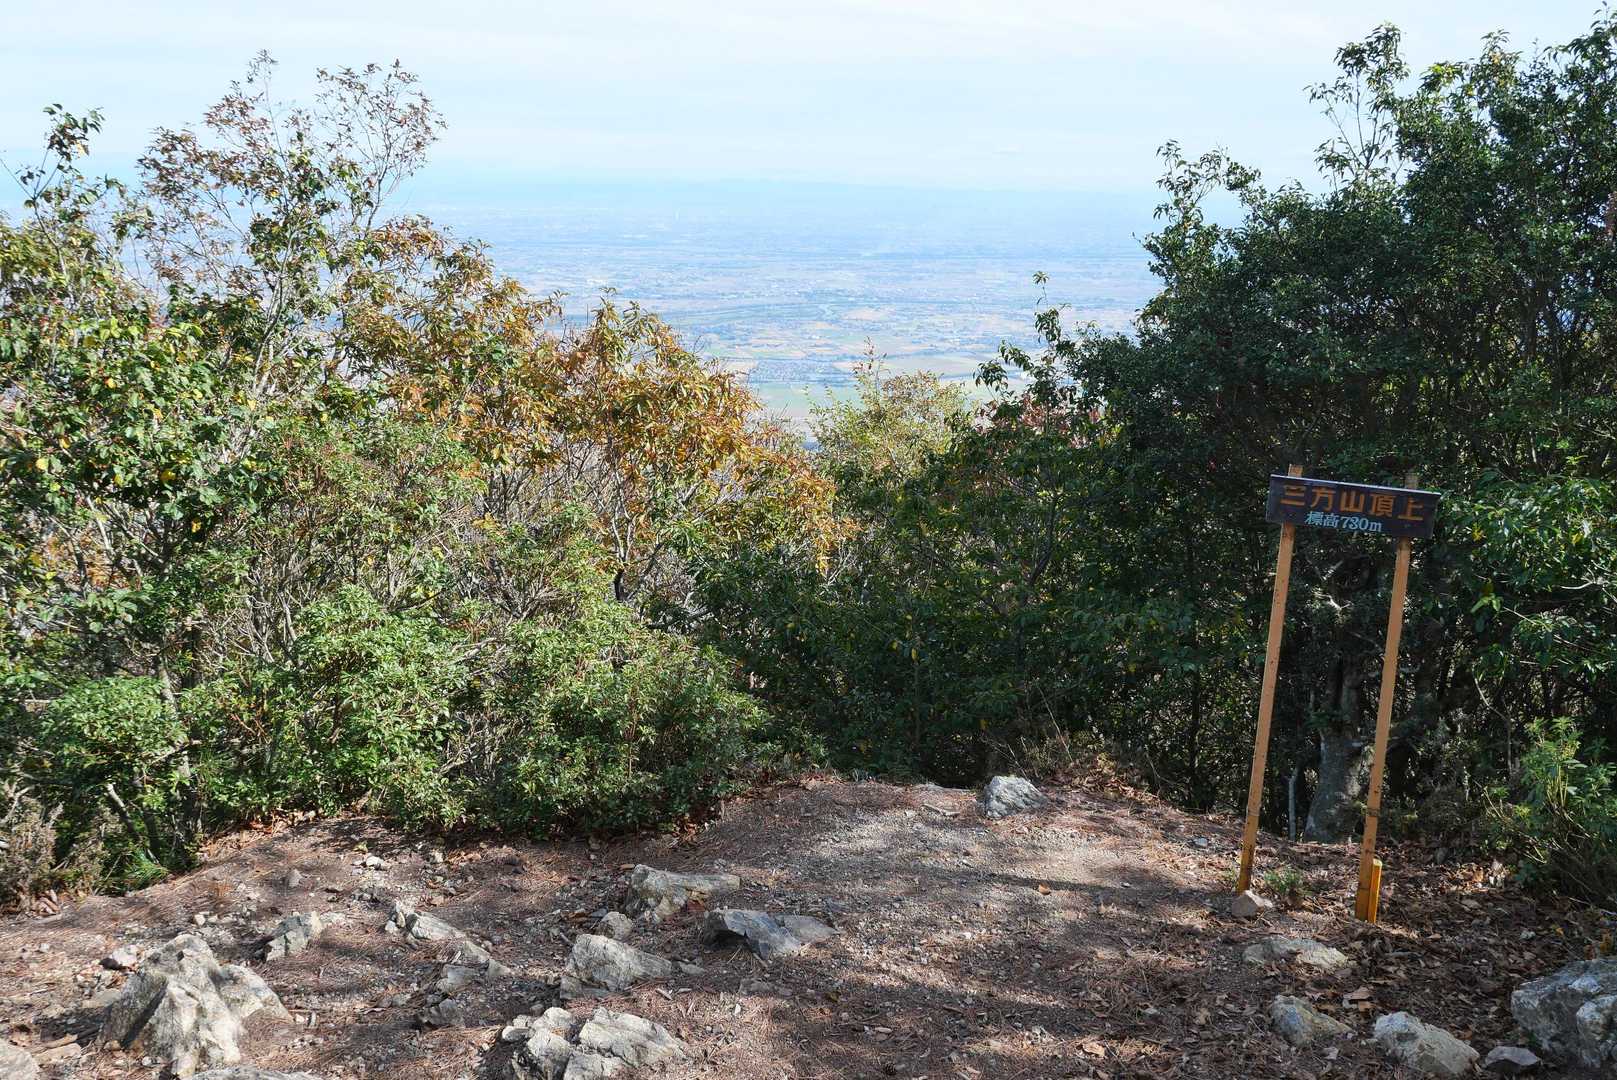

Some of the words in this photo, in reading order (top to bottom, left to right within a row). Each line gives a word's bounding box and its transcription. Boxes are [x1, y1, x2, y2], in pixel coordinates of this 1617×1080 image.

[1280, 485, 1424, 521] 三方山頂上
